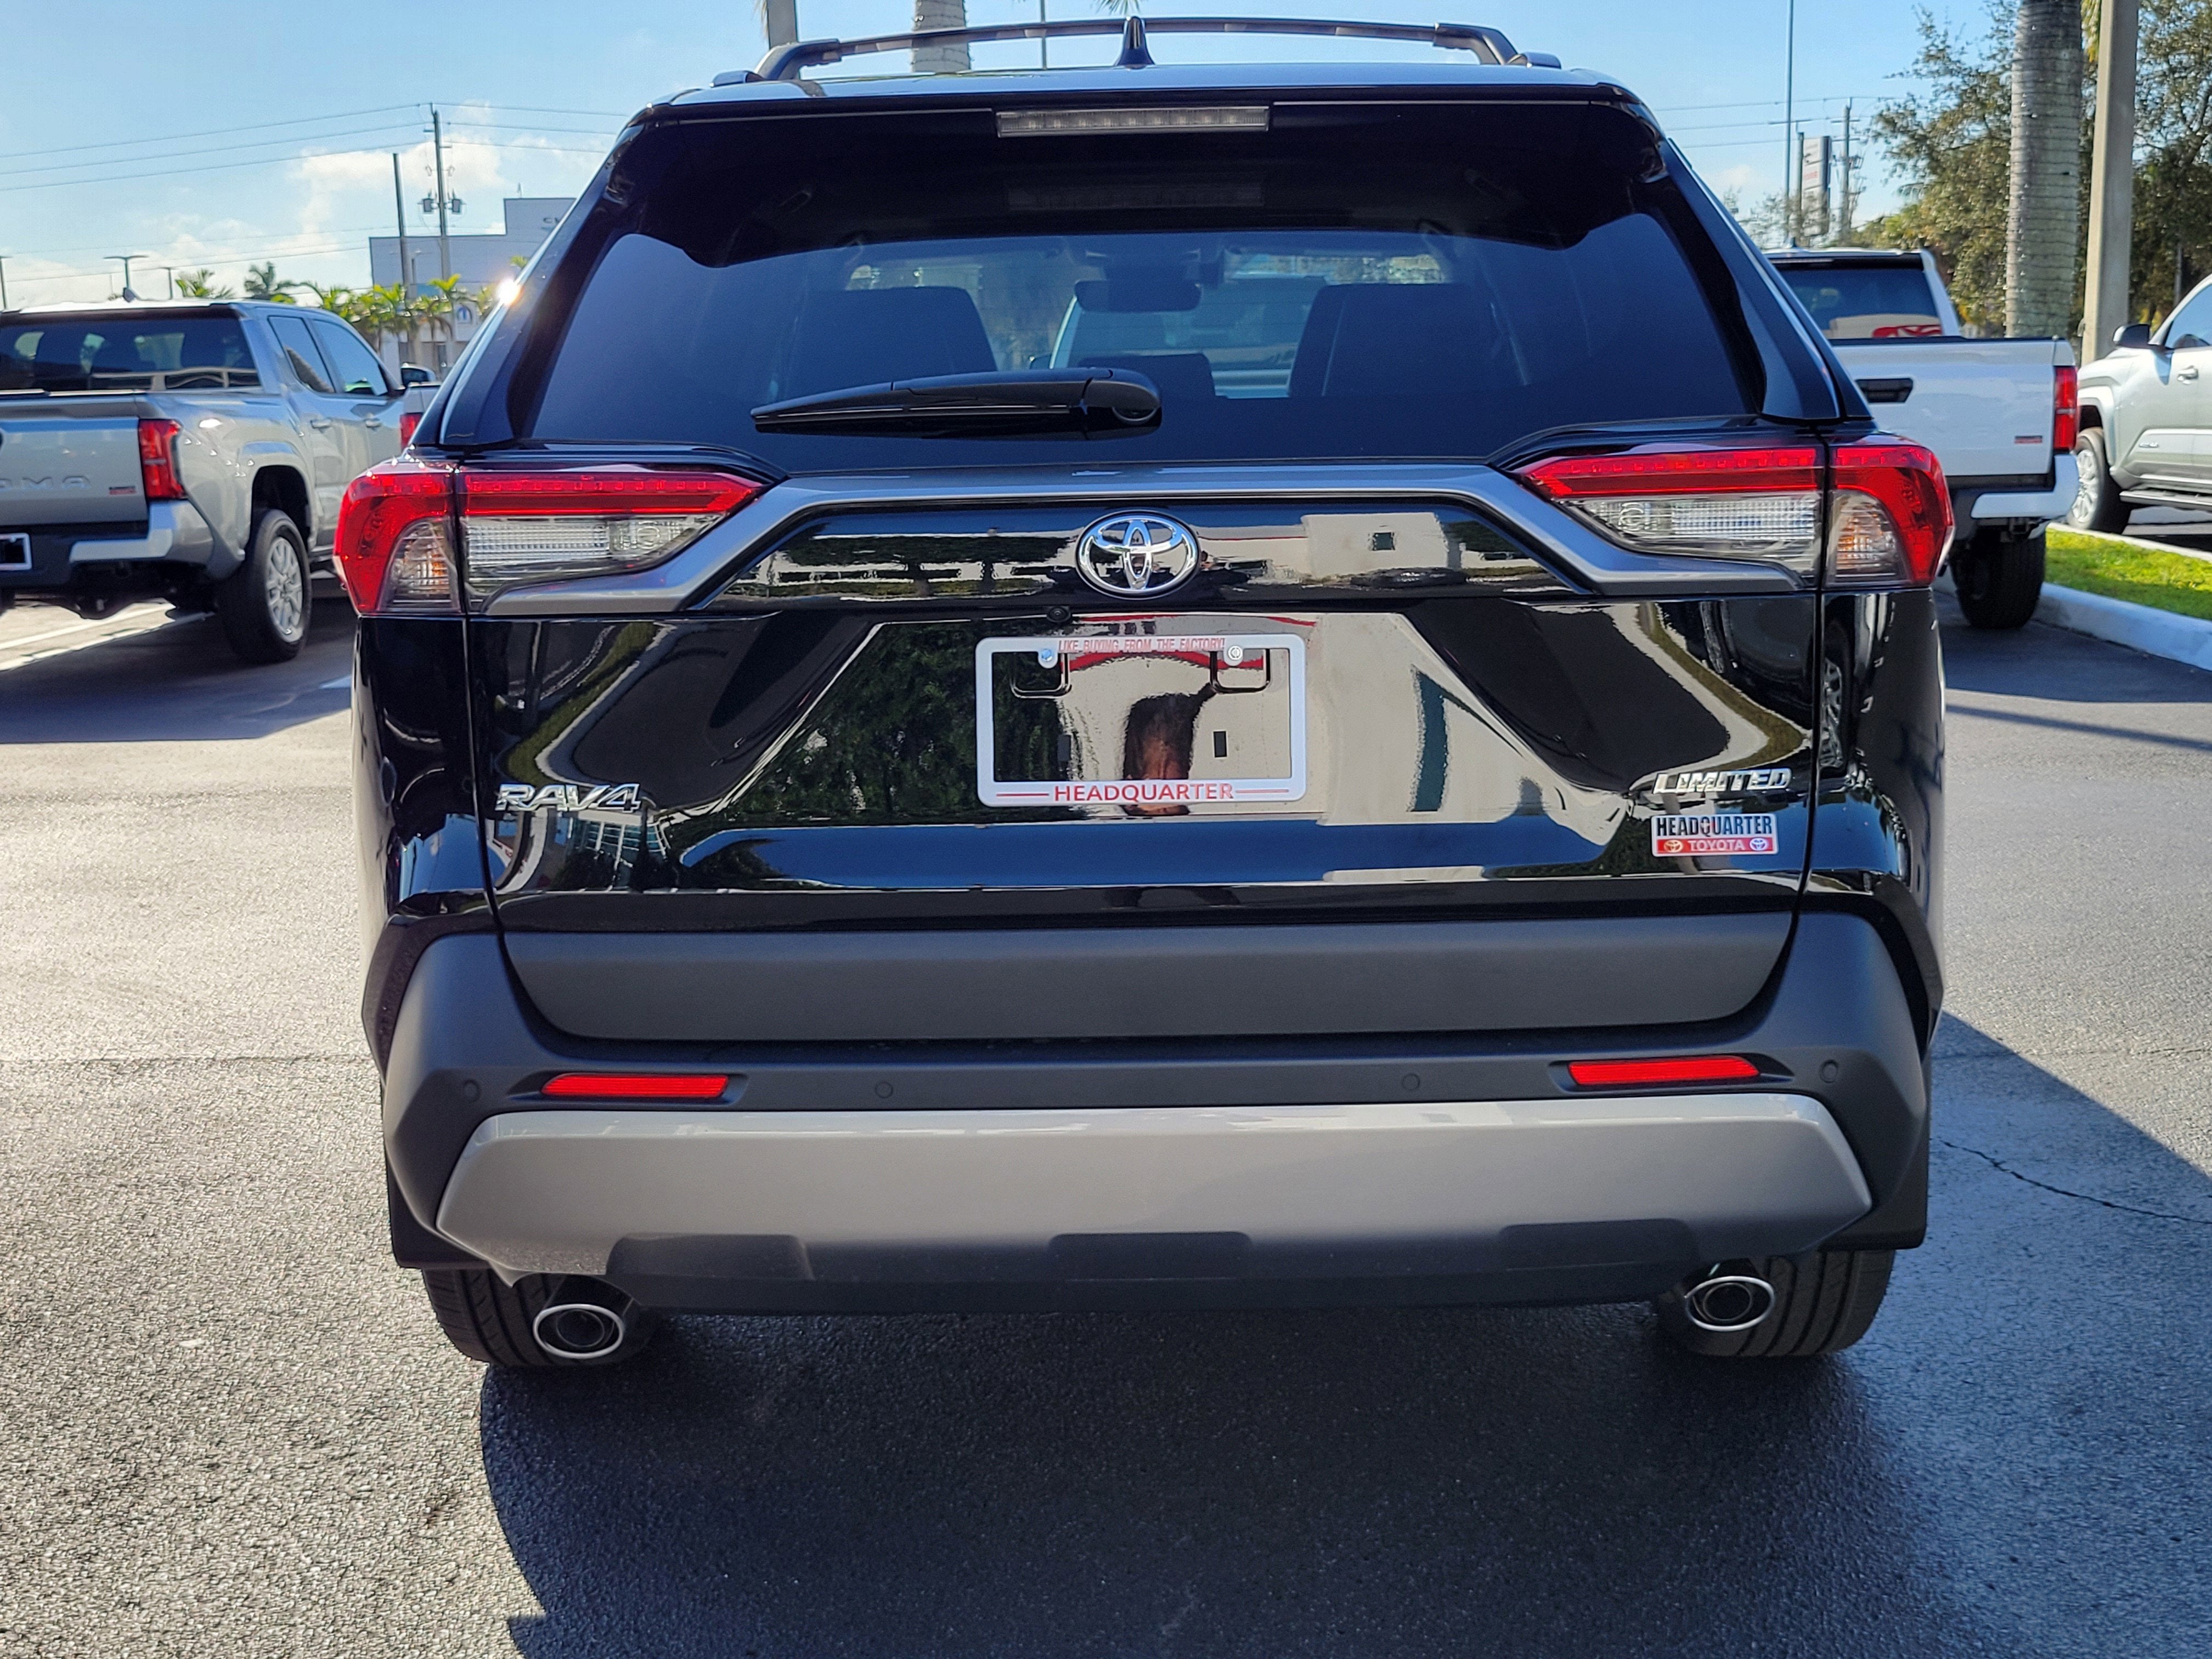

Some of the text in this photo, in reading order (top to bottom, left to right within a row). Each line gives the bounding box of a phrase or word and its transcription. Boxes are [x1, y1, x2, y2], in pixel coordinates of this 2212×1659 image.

[1058, 637, 1226, 652] LIKE BUYING FROM THE FACTORY!
[1652, 768, 1792, 794] LIMITED
[495, 783, 642, 814] RAV4
[1054, 783, 1234, 802] HEADQUARTER
[1656, 815, 1773, 837] HEADQUARTER
[1687, 839, 1746, 851] TOYOTA
